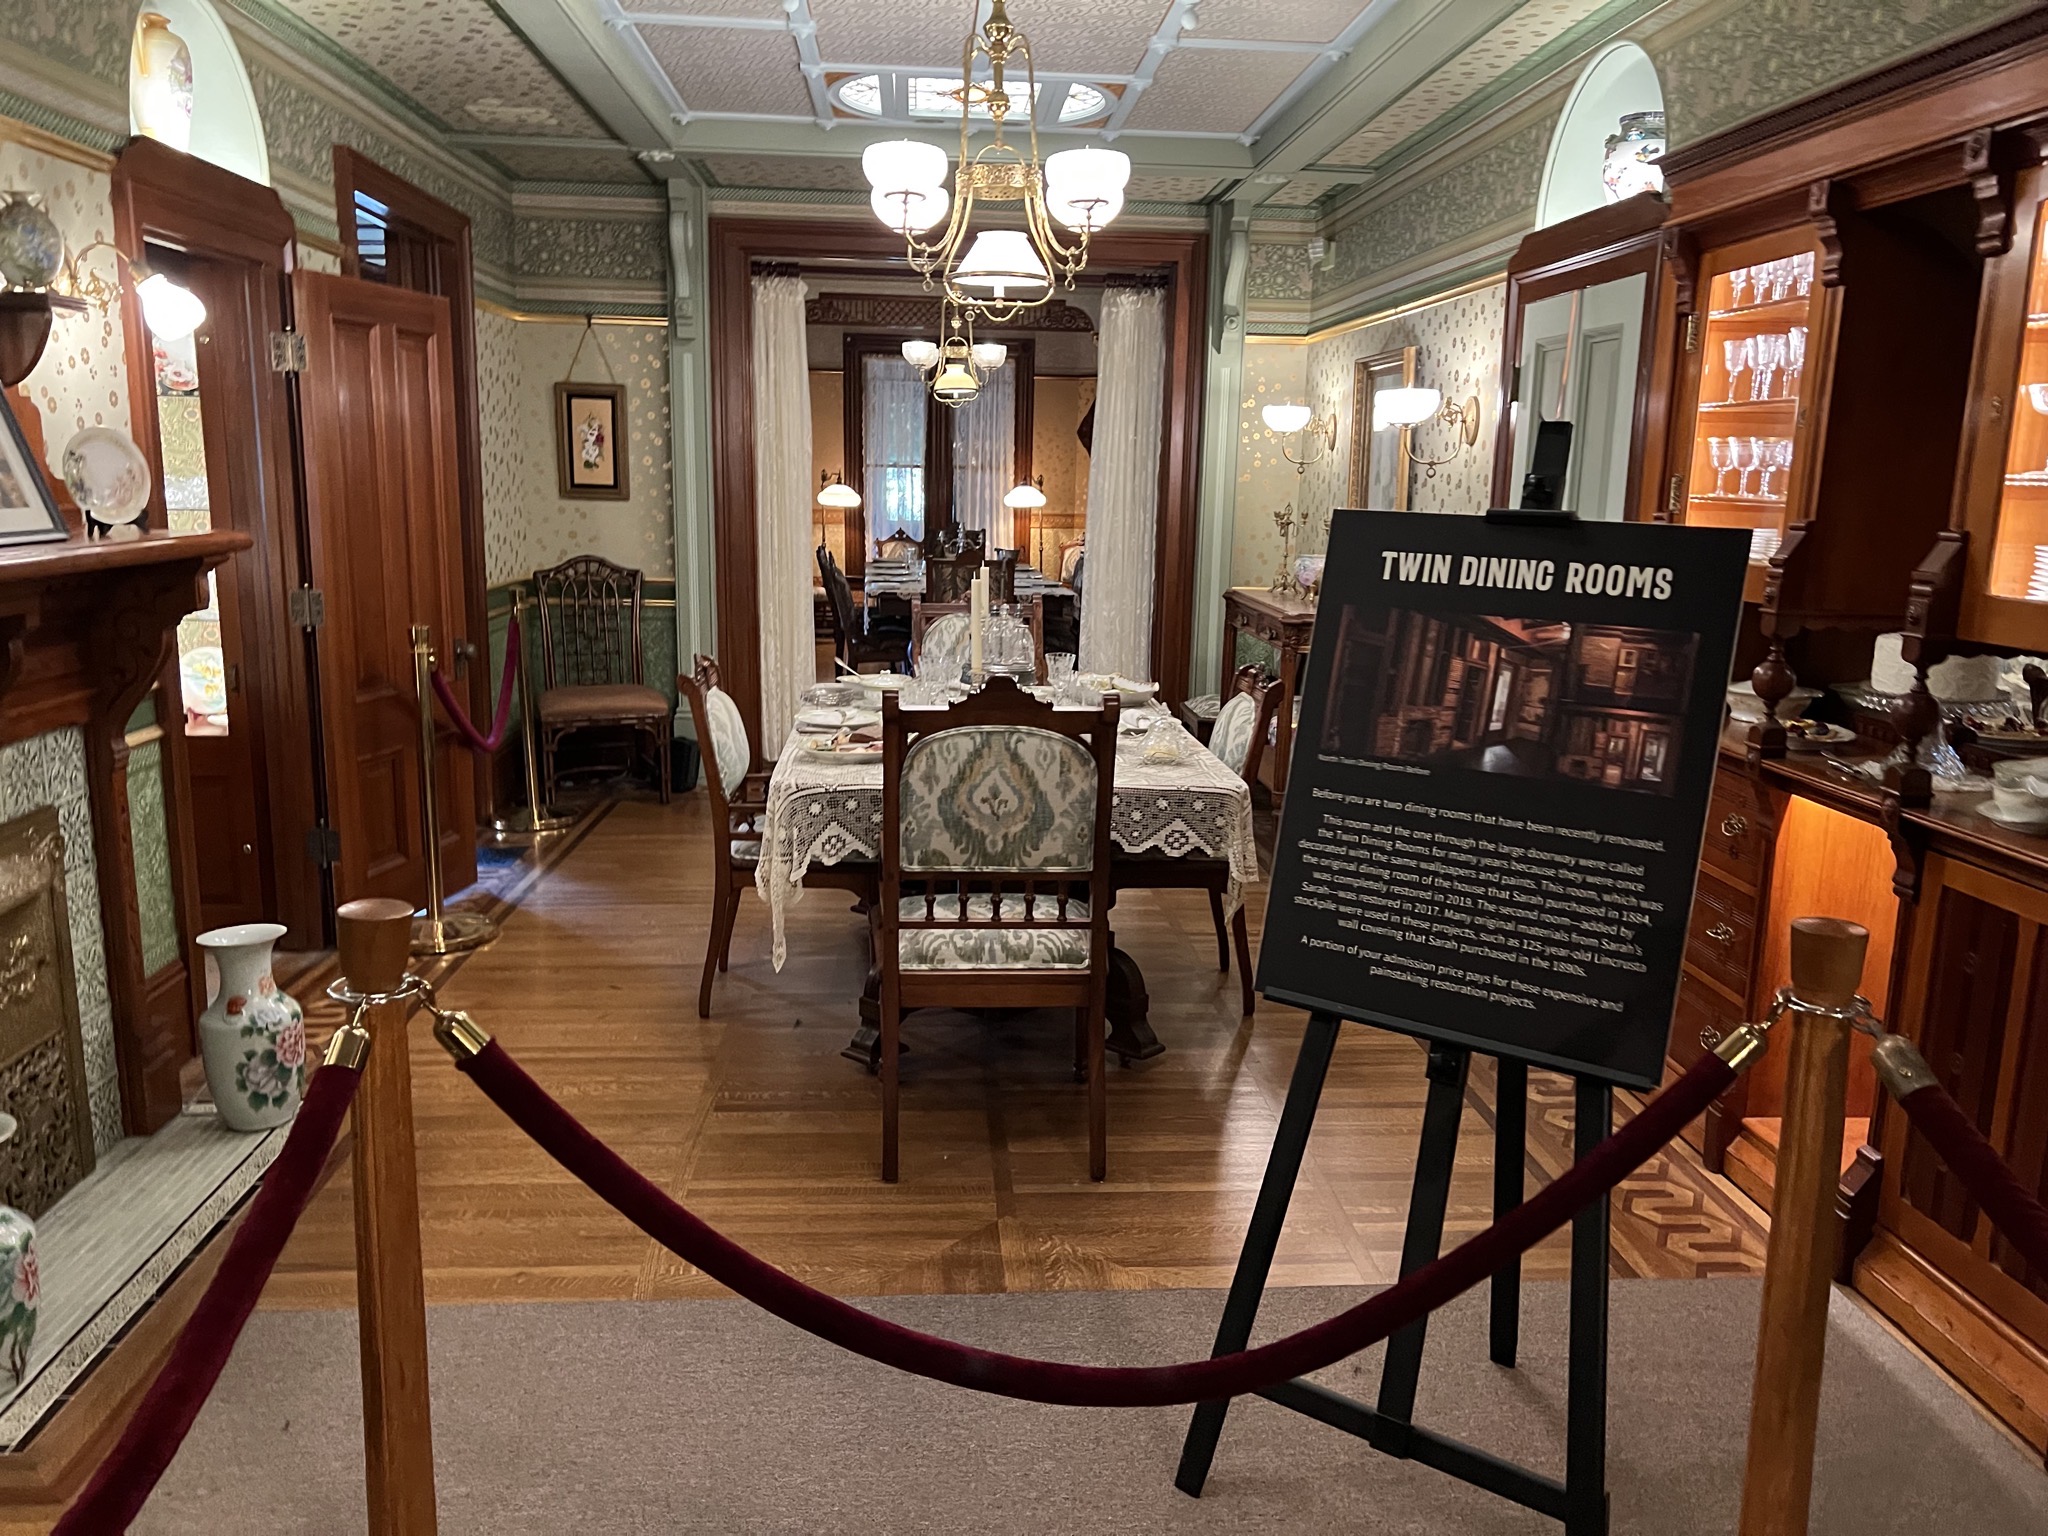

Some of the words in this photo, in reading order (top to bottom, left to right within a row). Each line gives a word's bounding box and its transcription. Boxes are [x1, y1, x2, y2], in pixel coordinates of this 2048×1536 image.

[1382, 551, 1452, 584] TWIN
[1460, 556, 1554, 591] DINING
[1565, 562, 1674, 600] ROOMS
[1312, 788, 1343, 801] Before
[1345, 794, 1363, 804] you
[1365, 797, 1381, 806] are
[1383, 799, 1402, 809] two
[1405, 802, 1437, 818] dining
[1438, 808, 1472, 822] rooms
[1475, 813, 1496, 825] that
[1498, 816, 1525, 829] have
[1527, 820, 1553, 833] been
[1555, 827, 1601, 843] recently
[1603, 834, 1666, 852] renovated.
[1323, 814, 1343, 825] This
[1344, 819, 1371, 830] room
[1372, 824, 1392, 834] and
[1395, 826, 1411, 837] the
[1413, 831, 1432, 840] one
[1435, 833, 1476, 849] through
[1478, 840, 1496, 851] the
[1498, 842, 1525, 858] large
[1527, 848, 1577, 866] doorway
[1578, 857, 1607, 869] were
[1608, 862, 1644, 876] called
[1298, 839, 1346, 855] decorated
[1349, 848, 1370, 859] with
[1372, 852, 1388, 862] the
[1390, 857, 1417, 867] same
[1419, 861, 1477, 878] wallpapers
[1479, 871, 1499, 882] and
[1541, 880, 1564, 892] This
[1566, 886, 1600, 900] room,
[1602, 892, 1638, 906] which
[1639, 900, 1664, 911] was
[1302, 854, 1319, 864] the
[1319, 858, 1357, 871] original
[1359, 864, 1390, 879] dining
[1392, 872, 1419, 882] room
[1422, 875, 1432, 885] of
[1434, 878, 1451, 888] the
[1452, 881, 1485, 895] house
[1488, 887, 1510, 899] that
[1513, 891, 1543, 905] Sarah
[1545, 899, 1605, 917] purchased
[1607, 907, 1619, 919] in
[1318, 828, 1334, 839] the
[1336, 830, 1358, 843] Twin
[1361, 835, 1393, 850] Dining
[1395, 840, 1429, 855] Rooms
[1432, 846, 1448, 857] for
[1448, 851, 1478, 866] many
[1478, 857, 1509, 868] years
[1510, 860, 1556, 876] because
[1558, 869, 1584, 883] they
[1585, 876, 1614, 887] were
[1615, 879, 1645, 892] once
[1294, 896, 1337, 910] stockpile
[1338, 904, 1363, 915] were
[1364, 909, 1388, 920] used
[1391, 912, 1400, 922] in
[1402, 916, 1431, 929] these
[1432, 922, 1477, 940] projects,
[1479, 932, 1505, 944] such
[1506, 937, 1520, 947] as
[1594, 953, 1647, 972] Lincrusta
[1312, 871, 1332, 881] was
[1333, 875, 1388, 893] completely
[1390, 885, 1432, 900] restored
[1433, 891, 1444, 902] in
[1446, 894, 1474, 908] 2019.
[1477, 900, 1497, 912] The
[1500, 905, 1538, 919] second
[1619, 926, 1635, 941] by
[1358, 893, 1400, 908] restored
[1402, 900, 1412, 911] in
[1415, 903, 1441, 917] 2017.
[1444, 909, 1473, 924] Many
[1474, 915, 1515, 931] original
[1517, 924, 1569, 942] materials
[1571, 932, 1599, 947] from
[1301, 935, 1308, 944] A
[1310, 938, 1345, 952] portion
[1347, 945, 1358, 954] of
[1358, 949, 1381, 958] your
[1383, 953, 1435, 971] admission
[1438, 965, 1464, 978] price
[1466, 969, 1490, 985] pays
[1492, 974, 1509, 987] for
[1511, 980, 1541, 995] these
[1542, 987, 1599, 1008] expensive
[1601, 999, 1624, 1012] and
[1338, 919, 1358, 929] wall
[1361, 924, 1403, 941] covering
[1405, 931, 1426, 943] that
[1428, 936, 1458, 949] Sarah
[1460, 943, 1517, 962] purchased
[1518, 953, 1529, 964] in
[1532, 956, 1550, 969] the
[1369, 965, 1428, 988] painstaking
[1430, 979, 1488, 999] restoration
